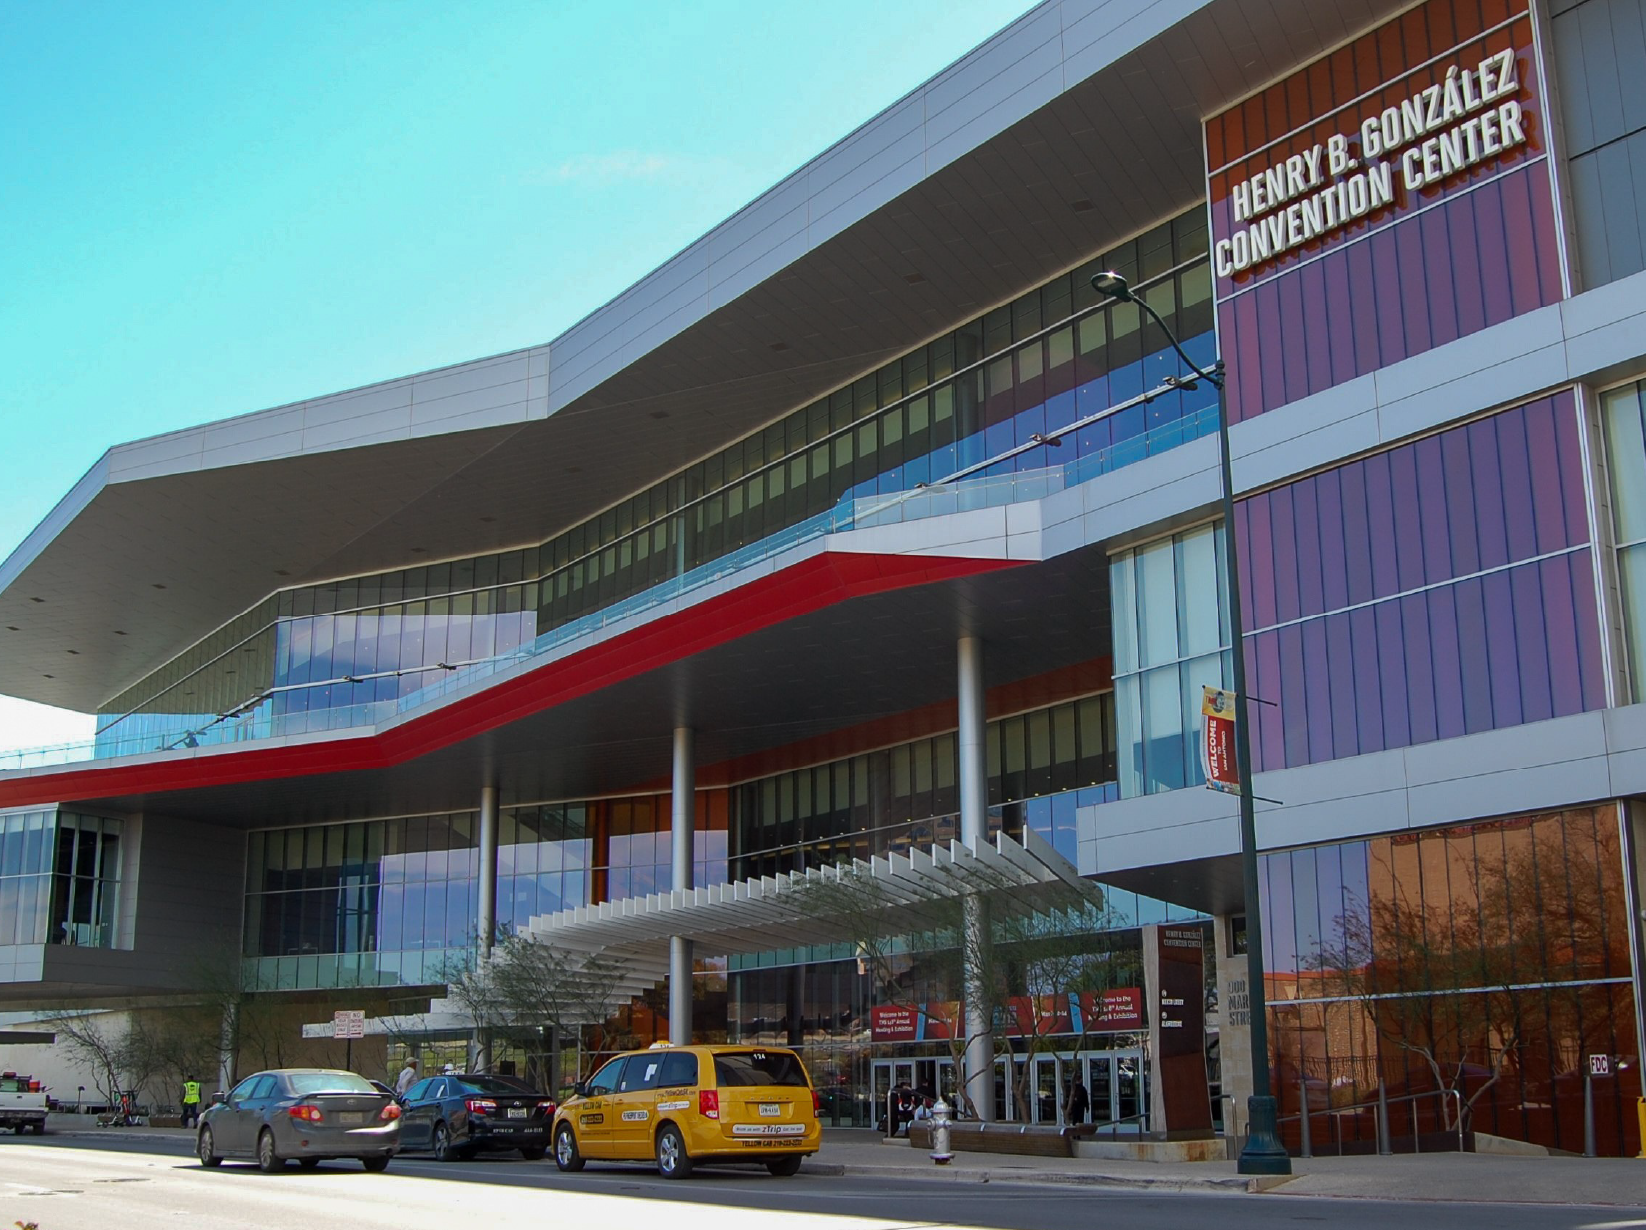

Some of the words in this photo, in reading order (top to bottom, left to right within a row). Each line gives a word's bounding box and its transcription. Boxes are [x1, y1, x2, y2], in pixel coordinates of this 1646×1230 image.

[1232, 143, 1323, 222] HENRY
[1328, 133, 1358, 175] B.
[1361, 47, 1520, 158] GONZÁLEZ
[1216, 162, 1393, 278] CONVENTION
[1402, 100, 1526, 190] CENTER
[1209, 719, 1220, 778] WELCOME
[1228, 994, 1250, 1010] MAR
[1113, 1012, 1138, 1020] Exhibition
[1229, 1010, 1251, 1027] STR
[1591, 1056, 1607, 1072] FDC
[762, 1125, 781, 1134] zTrip
